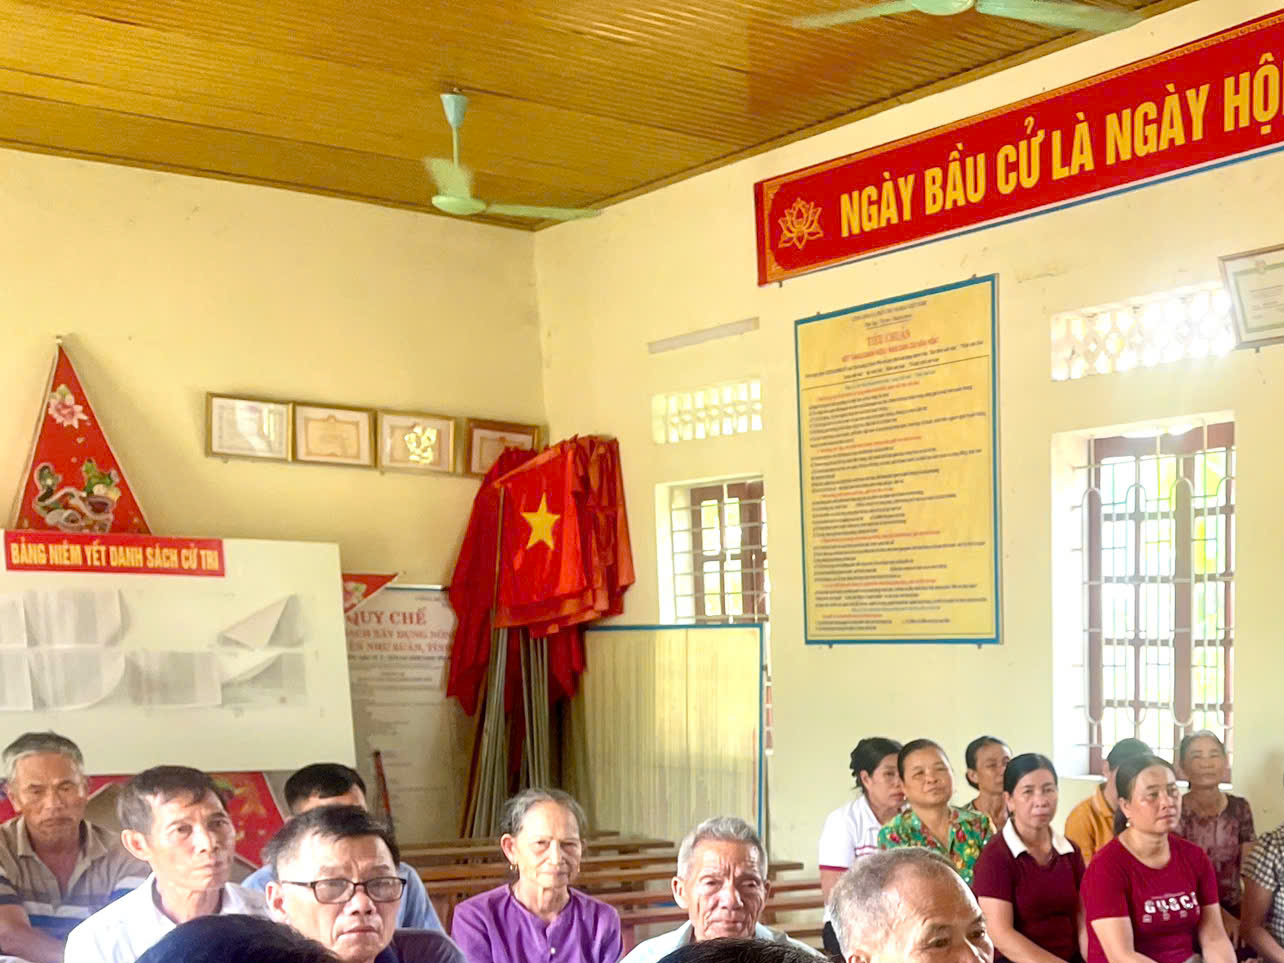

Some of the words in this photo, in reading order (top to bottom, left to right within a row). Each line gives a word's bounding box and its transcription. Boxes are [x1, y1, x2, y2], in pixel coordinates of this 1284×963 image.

[839, 170, 915, 237] NGÀY
[924, 142, 986, 215] BẦU
[997, 117, 1045, 195] CỬ
[1051, 112, 1095, 181] LÀ
[1105, 83, 1210, 166] NGÀY
[11, 536, 47, 565] BẢNG
[84, 539, 107, 566] YẾT
[109, 545, 143, 567] DANH
[146, 543, 178, 568] SÁCH
[181, 543, 197, 569] CỬ
[200, 549, 219, 571] TRI
